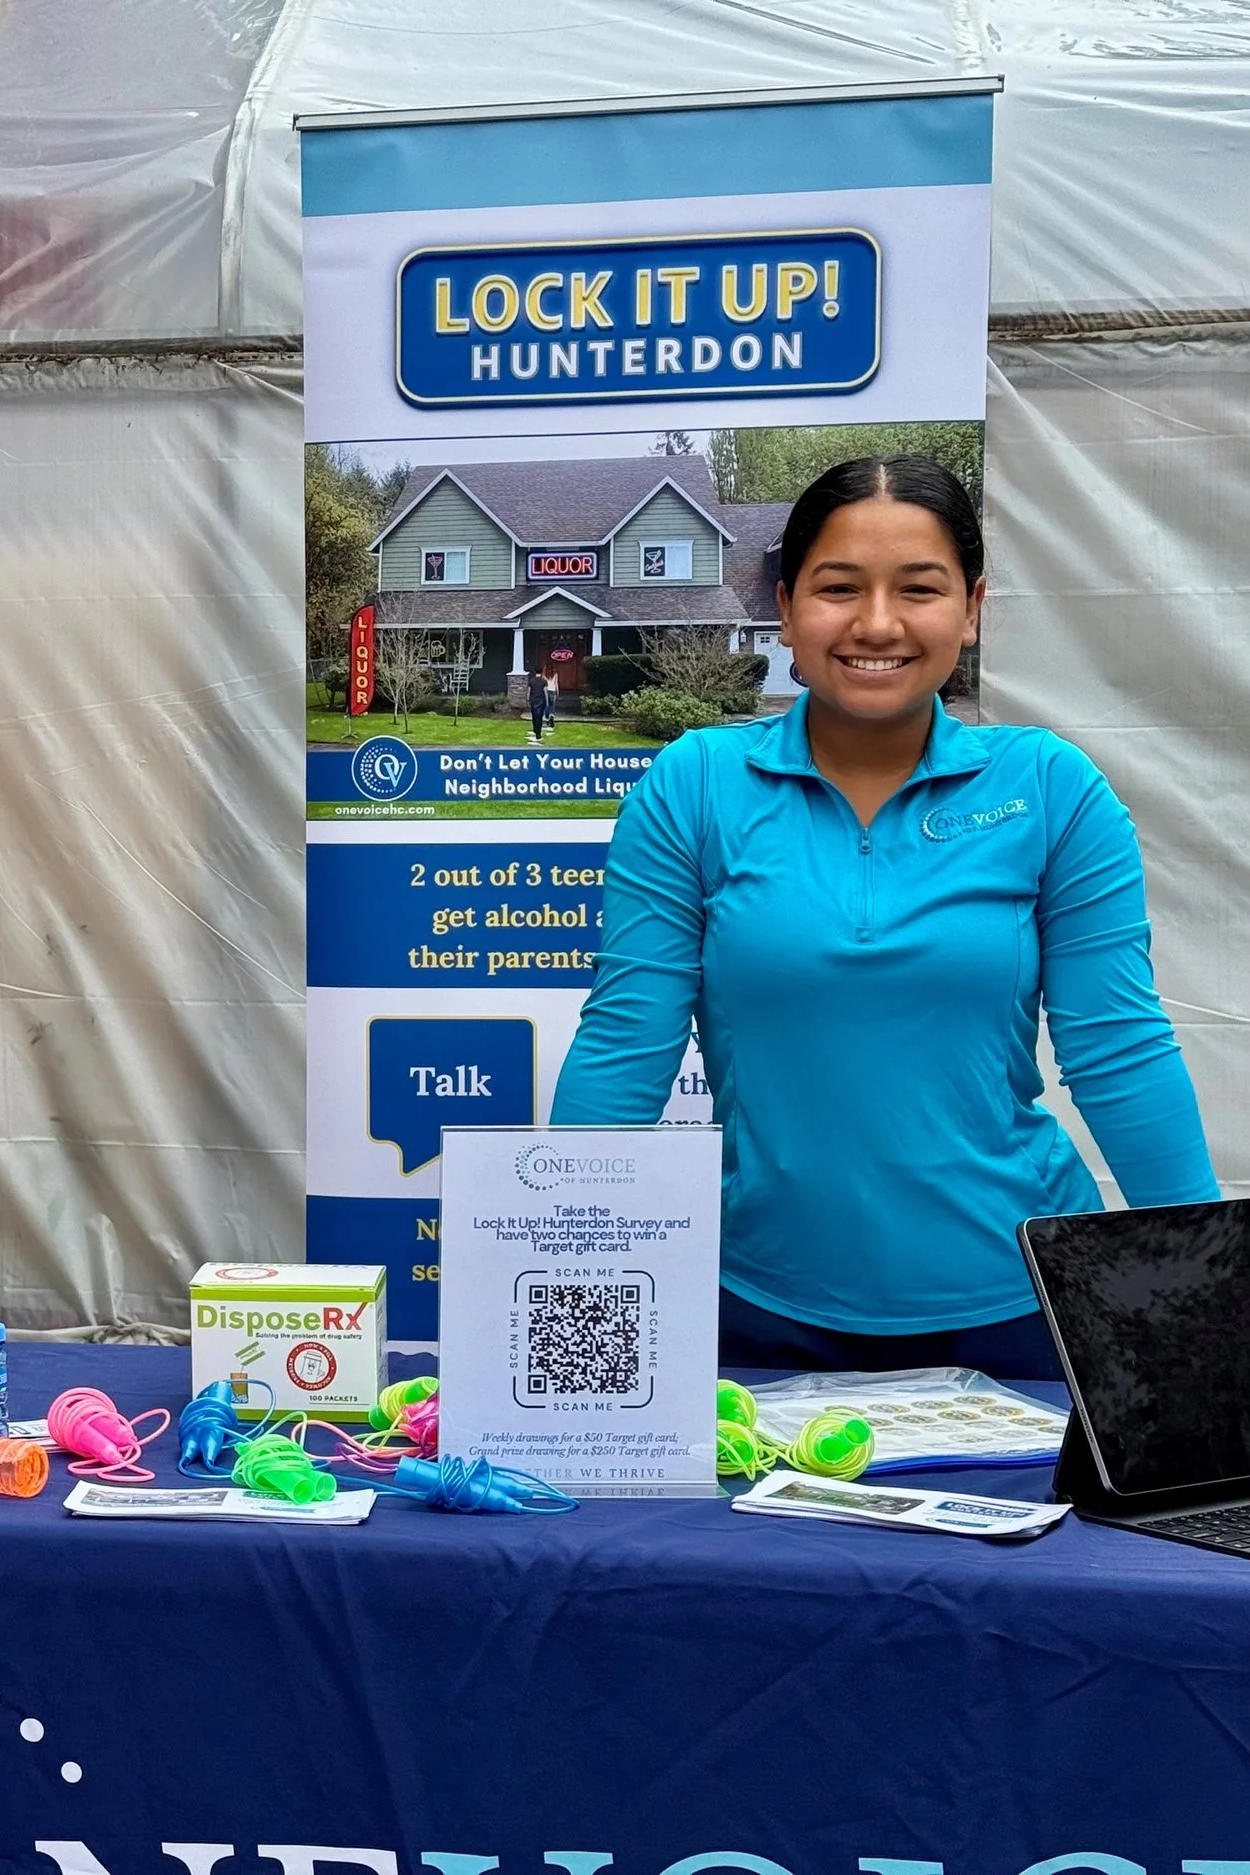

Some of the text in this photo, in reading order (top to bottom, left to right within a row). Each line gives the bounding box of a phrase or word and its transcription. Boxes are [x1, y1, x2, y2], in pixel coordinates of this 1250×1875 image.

[435, 259, 840, 335] LOCK IT UP!
[470, 331, 804, 382] HUNTERDON
[531, 556, 593, 575] LIQUOR
[356, 615, 369, 705] LIQUOR
[550, 650, 573, 661] OPEN
[440, 753, 653, 771] Don't Let Your House
[445, 777, 588, 798] Neighborhood
[335, 803, 435, 816] onevoicehc.com
[410, 863, 426, 887] 2
[434, 866, 483, 887] out
[490, 862, 520, 887] of
[526, 863, 542, 886] 3
[432, 907, 478, 935] get
[485, 903, 588, 928] alcohol
[408, 944, 596, 976] their parents
[409, 1064, 492, 1097] Talk
[533, 1158, 636, 1174] ONEVOICE
[553, 1205, 610, 1217] Take the
[474, 1217, 690, 1232] Lock It Up! Hunterdon Survey and
[496, 1229, 667, 1241] have two chances to win a
[531, 1240, 632, 1255] Target gift card.
[555, 1268, 615, 1277] SCAN ME
[196, 1300, 367, 1337] DisposeRx
[510, 1310, 519, 1368] SCAN ME
[649, 1310, 658, 1369] SCAN ME
[553, 1402, 613, 1411] SCAN ME
[482, 1432, 679, 1445] Weekly drawings for a $50 Target gift card;
[469, 1446, 499, 1457] Grand
[500, 1446, 525, 1458] prize
[525, 1446, 566, 1458] drawing
[565, 1446, 582, 1458] for
[590, 1446, 616, 1457] $250
[618, 1446, 649, 1458] Target
[650, 1445, 667, 1458] gift
[667, 1446, 691, 1456] card.
[580, 1468, 602, 1478] WE
[610, 1468, 665, 1478] THRIVE
